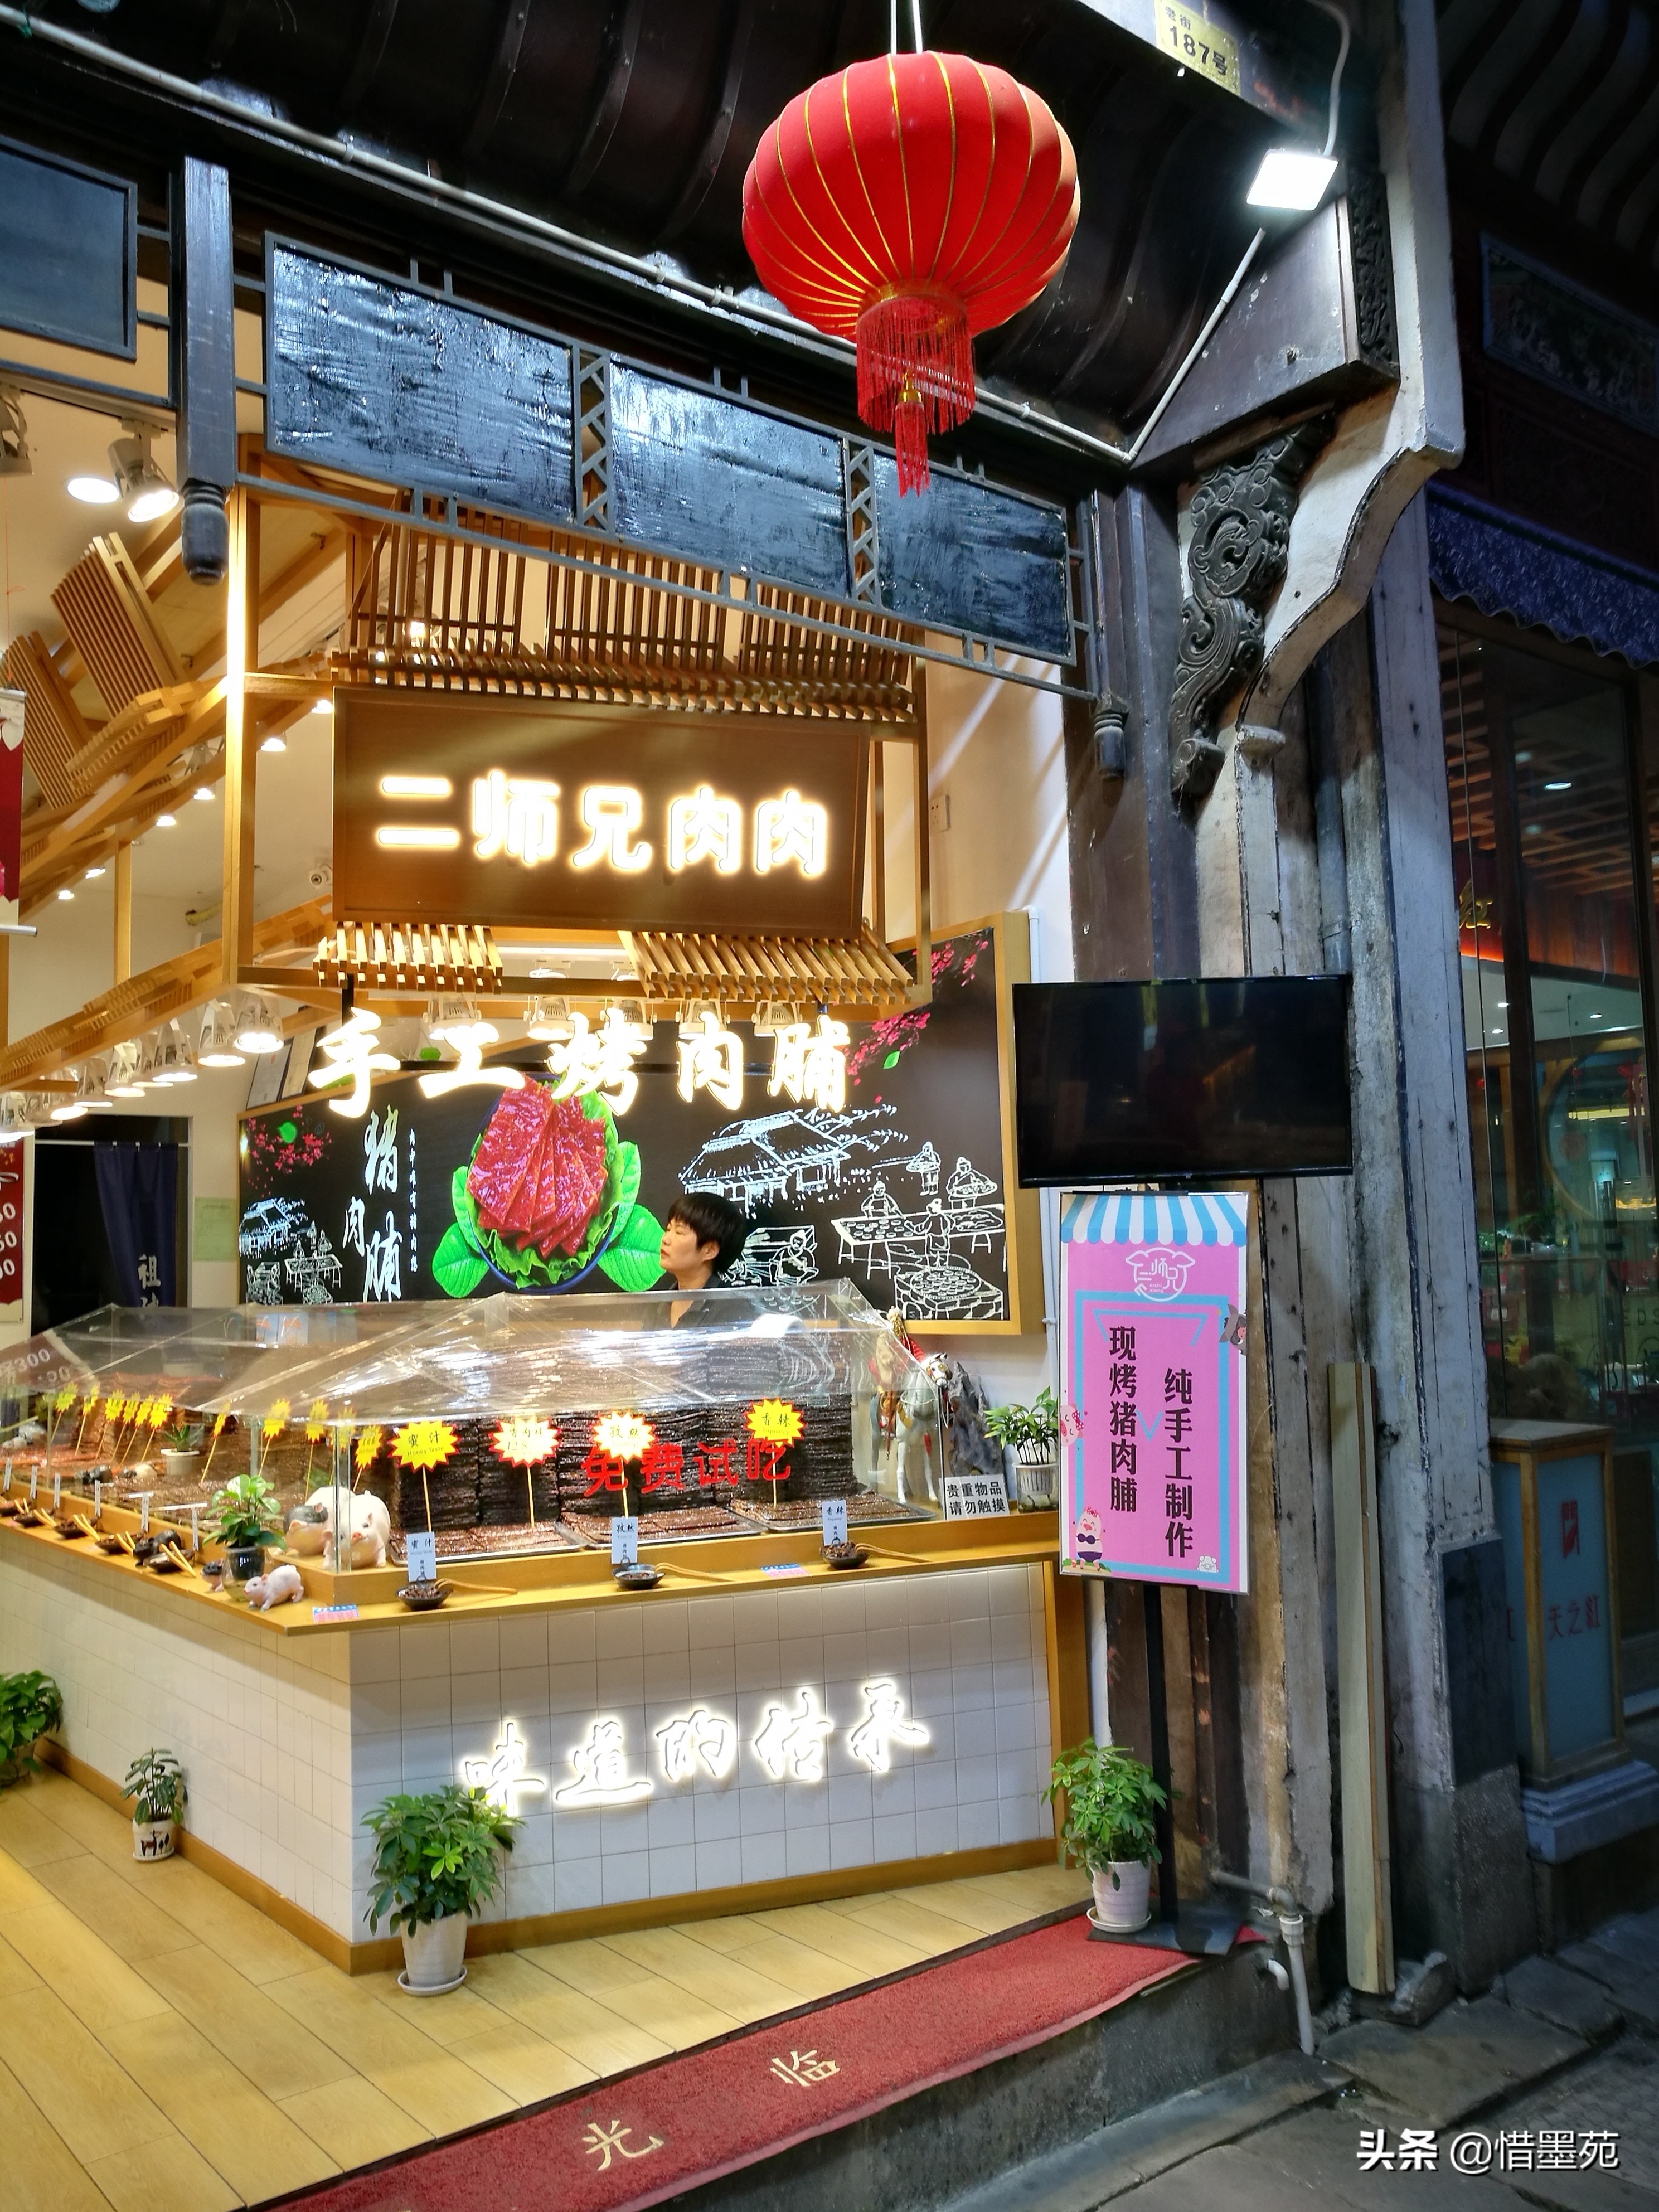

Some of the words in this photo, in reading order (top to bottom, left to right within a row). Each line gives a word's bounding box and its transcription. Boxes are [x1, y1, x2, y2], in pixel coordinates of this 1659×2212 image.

[1170, 26, 1227, 76] 187号
[377, 770, 828, 875] 二师兄肉肉
[308, 1007, 852, 1118] 手工烤肉脯
[1138, 1258, 1180, 1292] 二师兄
[408, 1430, 440, 1447] 蜜汁
[610, 1425, 641, 1439] 孜然
[761, 1412, 790, 1427] 香辣
[1109, 1326, 1137, 1513] 现烤猪肉脯
[581, 1438, 791, 1497] 免费试吃
[1165, 1367, 1194, 1558] 纯手工制作
[947, 1481, 1002, 1498] 贵重物品
[949, 1500, 1006, 1516] 请勿触摸
